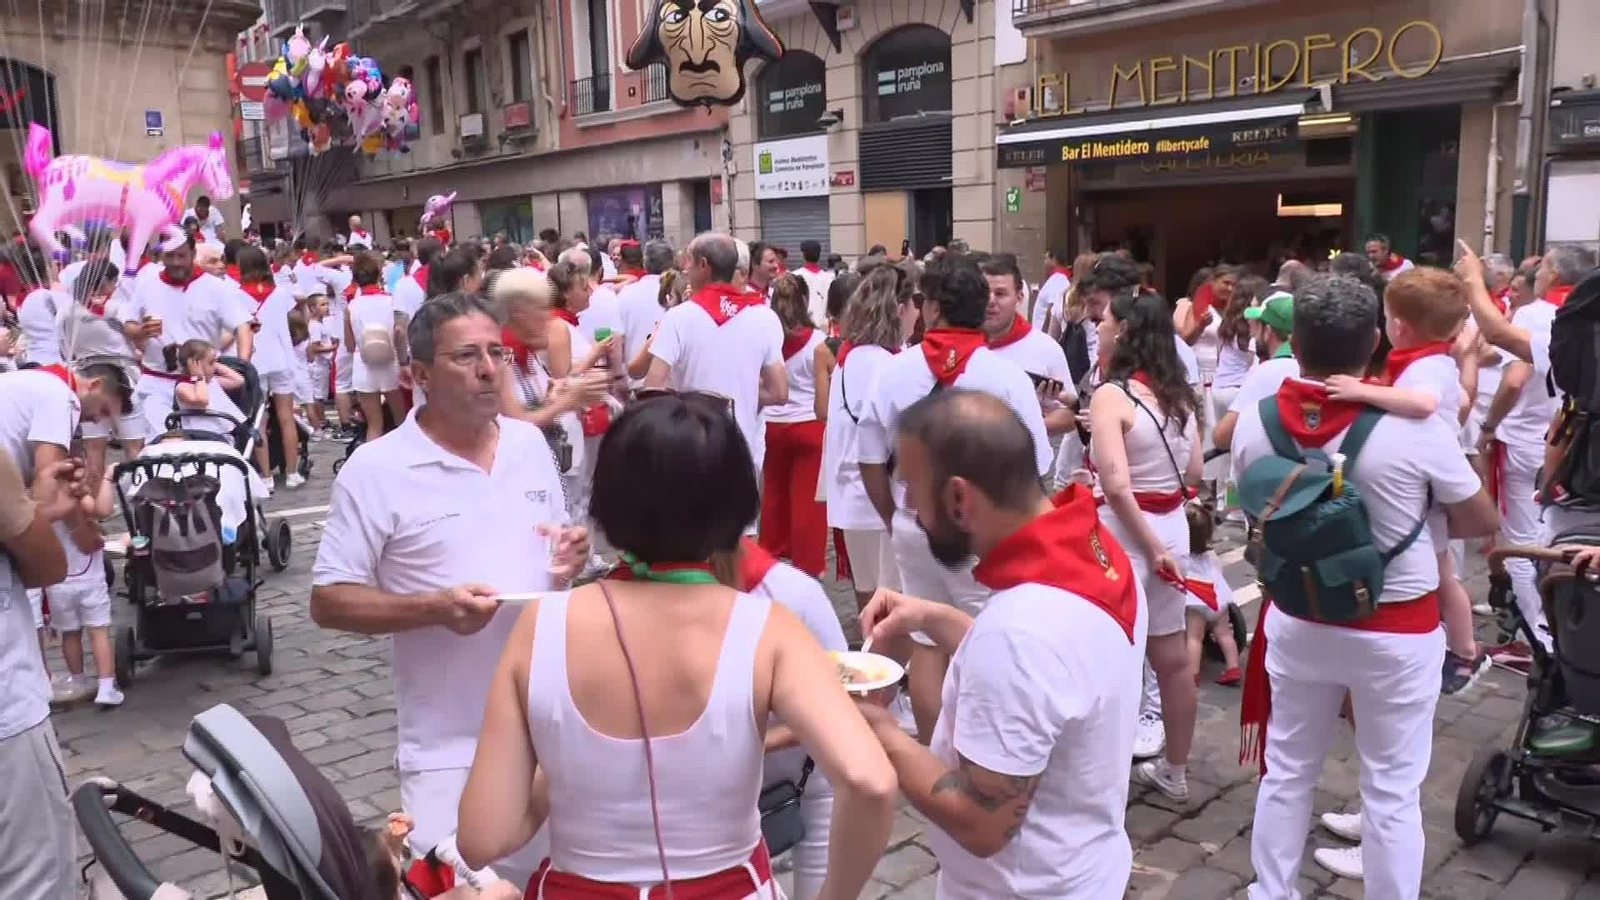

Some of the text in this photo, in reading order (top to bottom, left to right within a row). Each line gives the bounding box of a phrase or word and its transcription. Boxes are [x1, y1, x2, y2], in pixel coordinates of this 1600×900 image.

[898, 61, 944, 79] pamplona
[1038, 20, 1444, 118] EL MENTIDERO
[785, 83, 822, 99] pamplona
[898, 78, 921, 93] iruña
[785, 98, 804, 110] iruña
[1062, 136, 1211, 161] Bar El Mentidero #libertycafe
